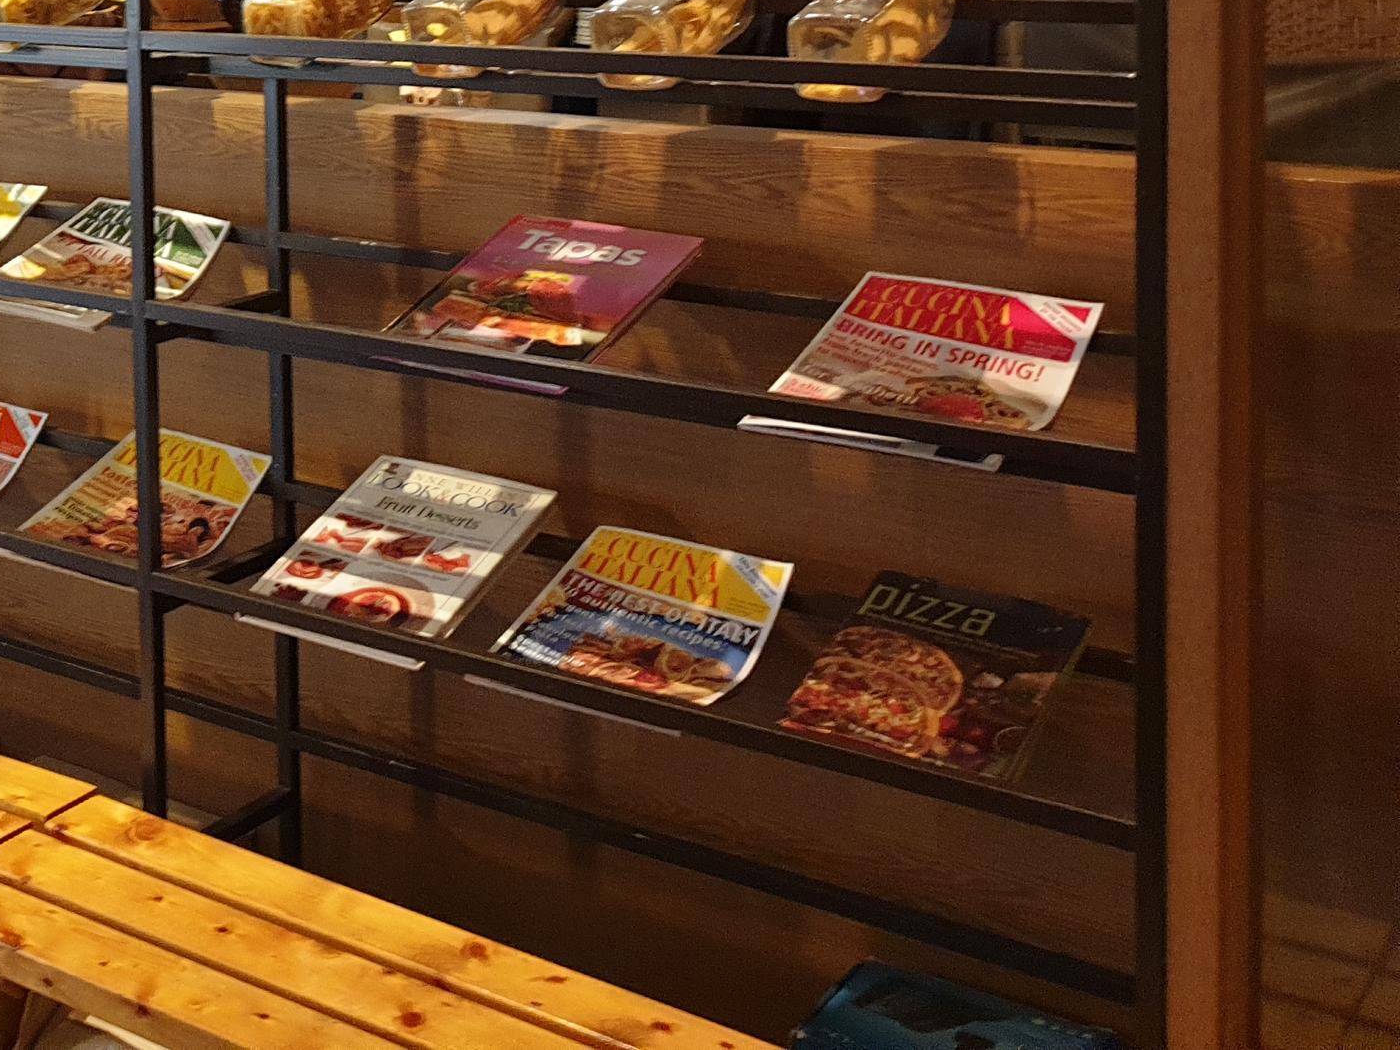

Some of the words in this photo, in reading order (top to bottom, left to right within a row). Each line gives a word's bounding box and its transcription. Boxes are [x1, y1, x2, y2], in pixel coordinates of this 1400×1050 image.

[517, 229, 648, 267] Tapas
[851, 300, 1014, 350] ITALIANA
[882, 283, 1012, 325] CUCINA
[836, 317, 907, 351] BRING
[914, 339, 940, 359] IN
[945, 348, 1047, 383] SPRING!
[375, 495, 417, 514] Fruit
[416, 505, 482, 530] Desserts
[579, 552, 721, 609] ITALIANA
[607, 536, 719, 583] CUCINA
[699, 614, 761, 647] ITALY
[856, 582, 997, 637] pizza
